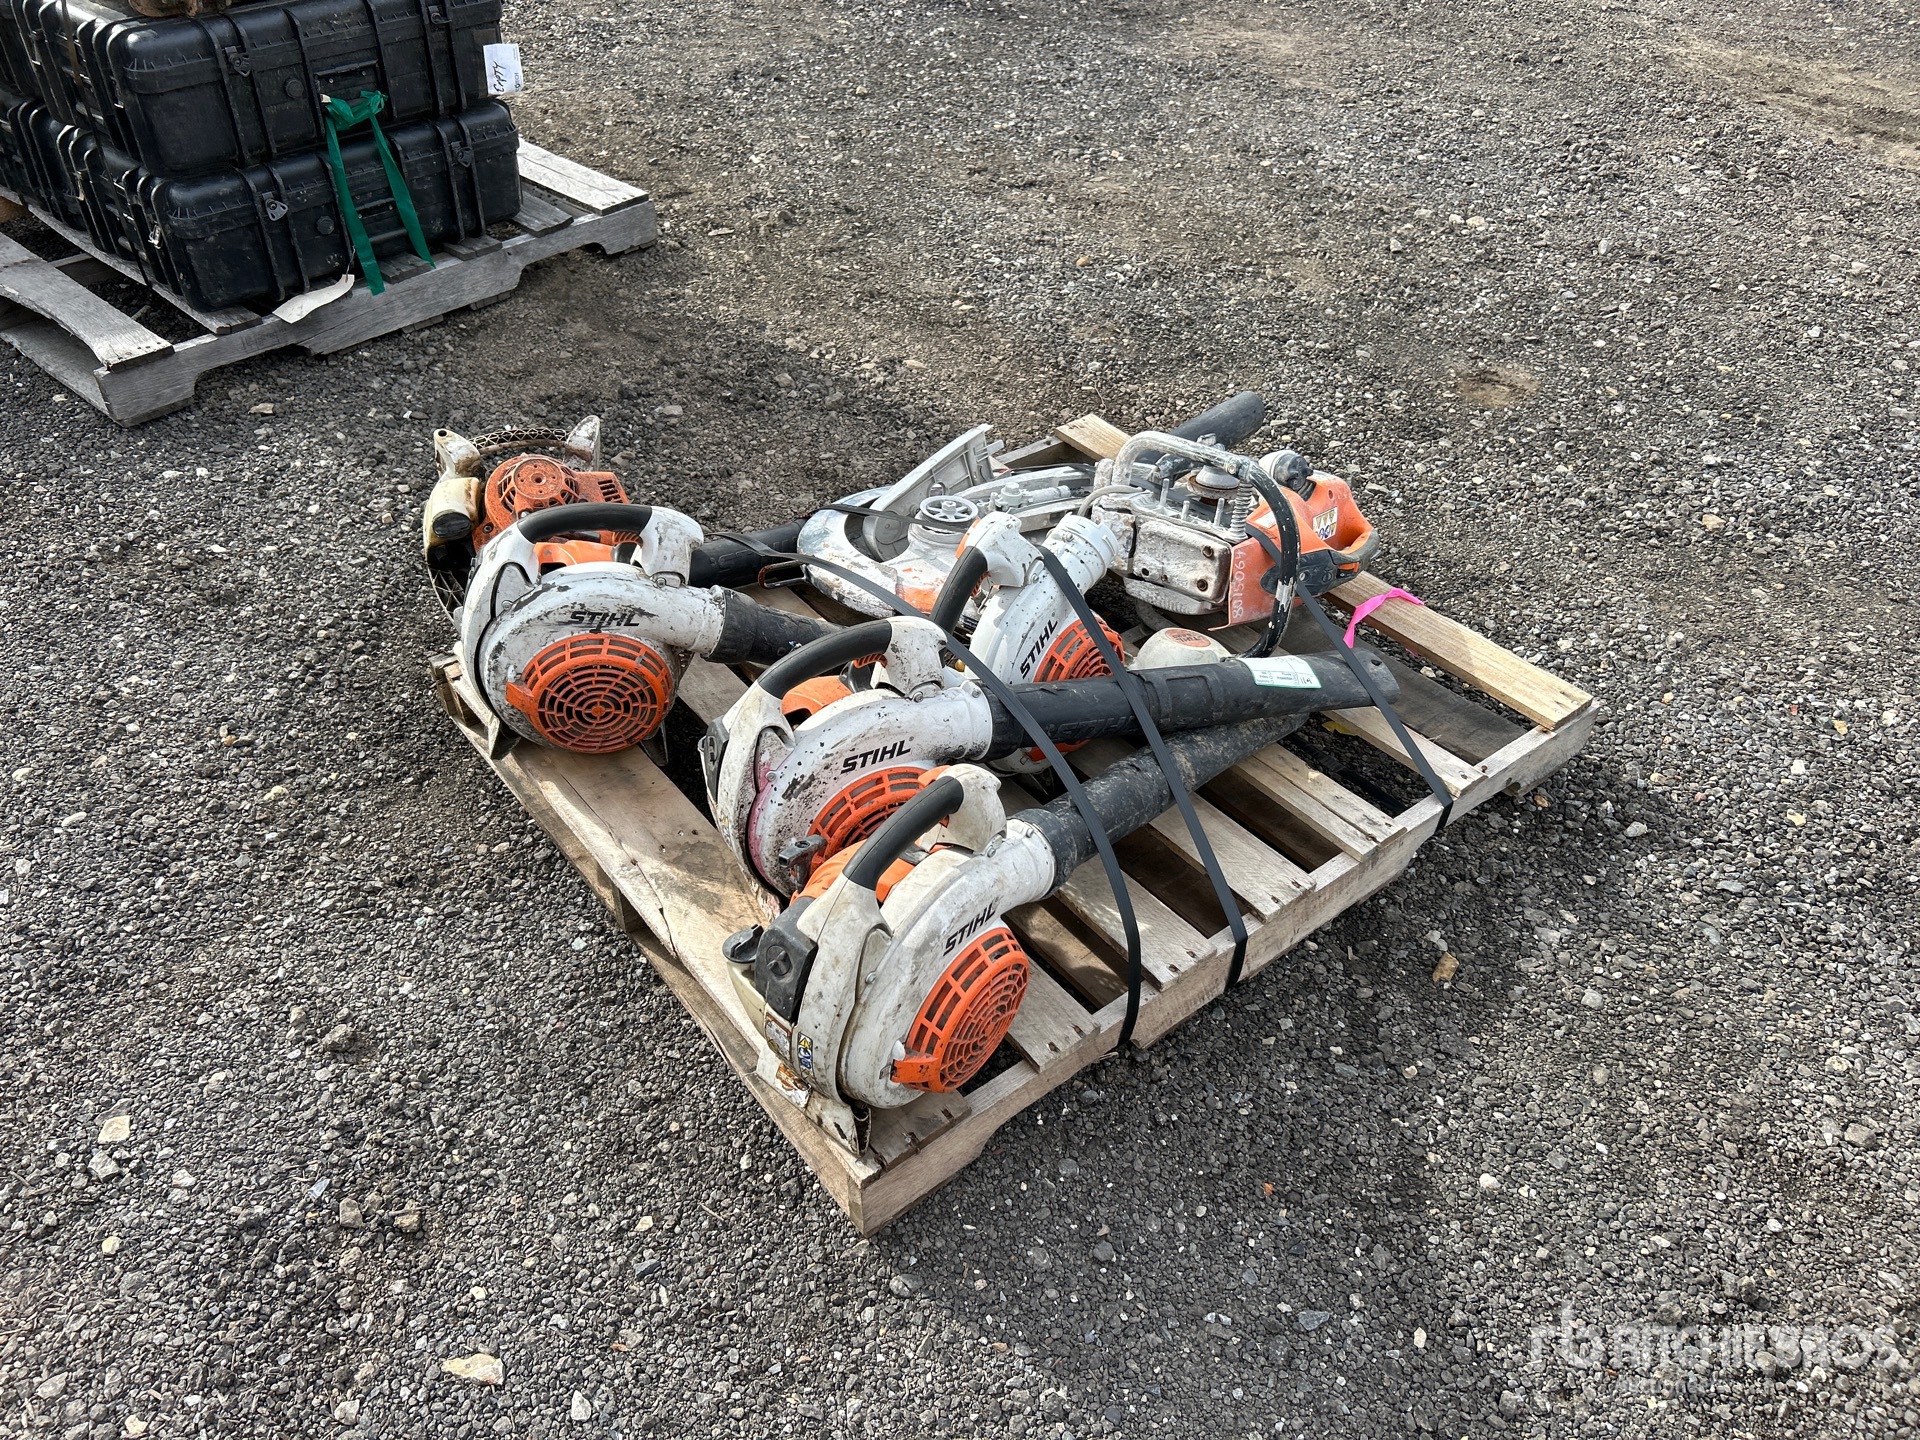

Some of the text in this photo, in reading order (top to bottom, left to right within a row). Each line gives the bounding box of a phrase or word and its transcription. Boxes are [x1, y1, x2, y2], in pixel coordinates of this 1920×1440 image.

[570, 611, 640, 627] STIHL
[1020, 619, 1058, 680] STIHL
[840, 740, 911, 774] STIHL
[943, 902, 996, 957] STIHL
